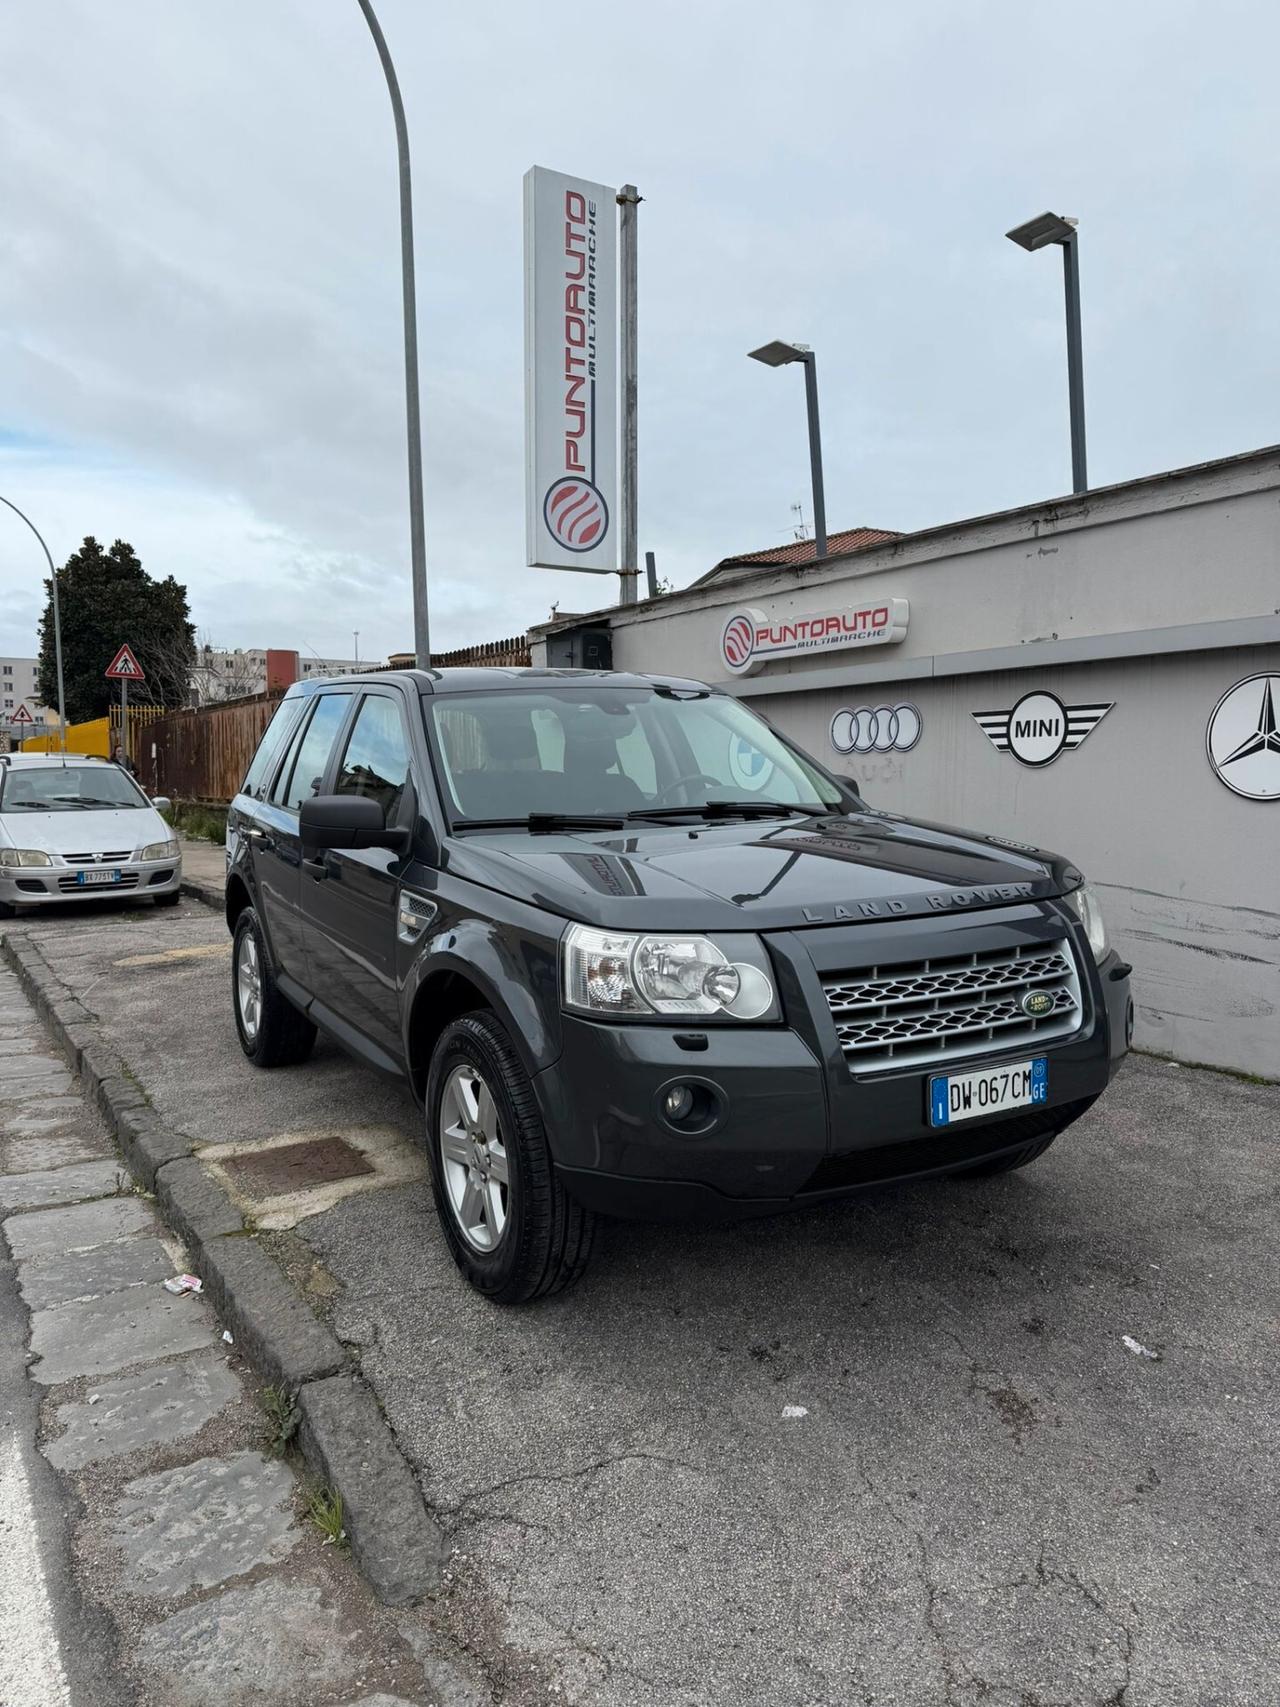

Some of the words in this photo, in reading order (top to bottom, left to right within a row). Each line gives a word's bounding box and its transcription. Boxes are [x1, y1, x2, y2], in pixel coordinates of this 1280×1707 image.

[589, 200, 597, 378] MULTIMARCHE
[565, 190, 586, 472] PUNTOAUTO
[756, 607, 888, 646] PUNTOAUTO
[797, 629, 886, 649] MULTIMARCHE
[1015, 718, 1060, 738] MINI
[802, 901, 908, 922] LAND
[926, 885, 1034, 910] ROVER
[1032, 1082, 1045, 1100] GE
